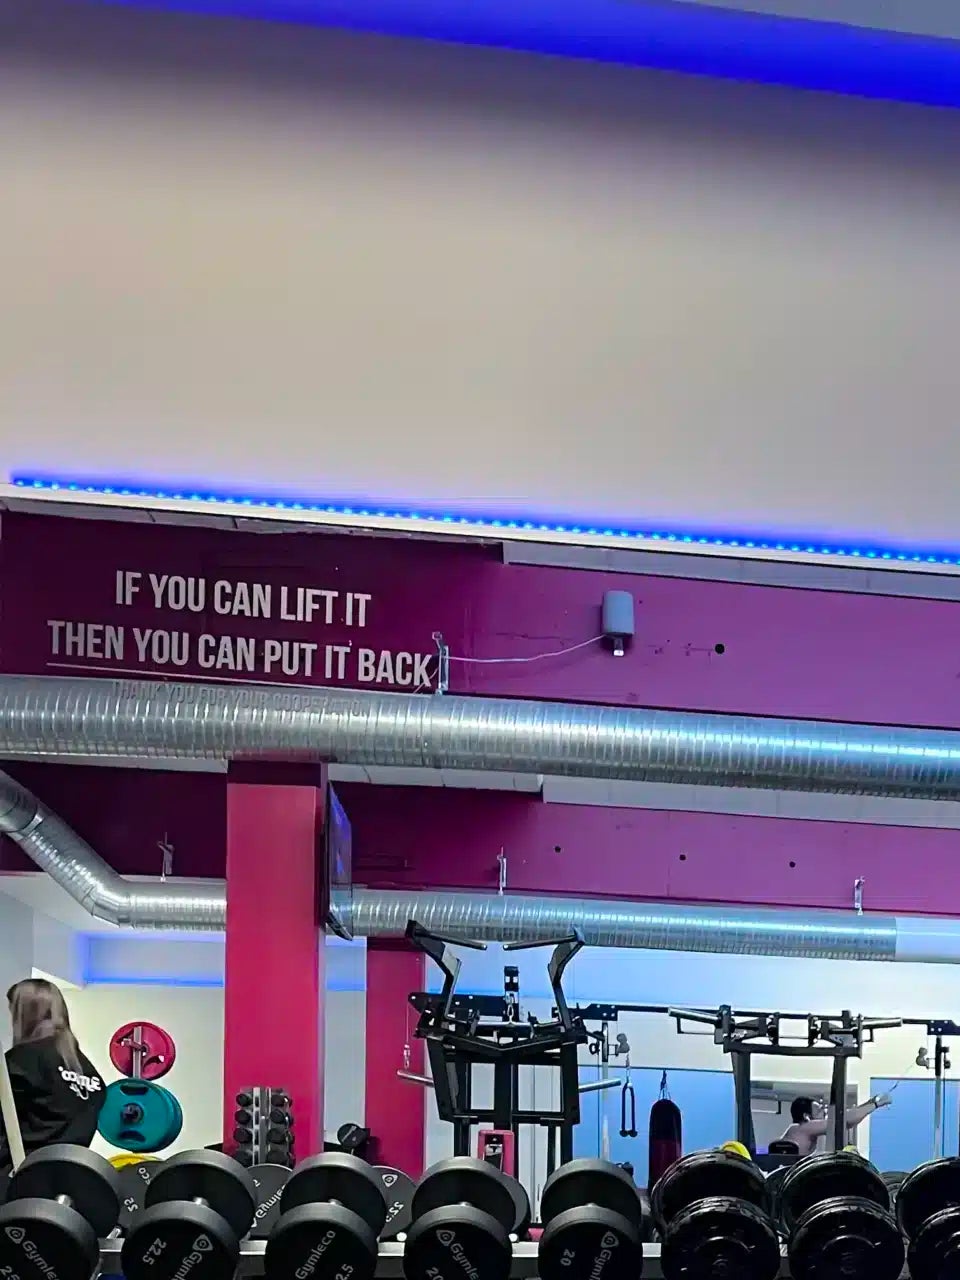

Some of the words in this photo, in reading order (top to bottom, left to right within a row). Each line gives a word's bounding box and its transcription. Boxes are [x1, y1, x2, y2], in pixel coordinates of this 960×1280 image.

[116, 570, 141, 605] IF
[149, 573, 205, 612] YOU
[214, 580, 271, 618] CAN
[280, 586, 338, 625] LIFT
[346, 592, 371, 627] IT
[47, 620, 124, 660] THEN
[132, 628, 189, 666] YOU
[198, 634, 258, 671] CAN
[264, 640, 317, 677] PUT
[325, 645, 350, 680] IT
[358, 648, 432, 687] BACK
[167, 684, 195, 704] YOU
[142, 1238, 167, 1265] 22.5
[295, 1230, 336, 1280] Gymleco
[560, 1248, 577, 1267] 20
